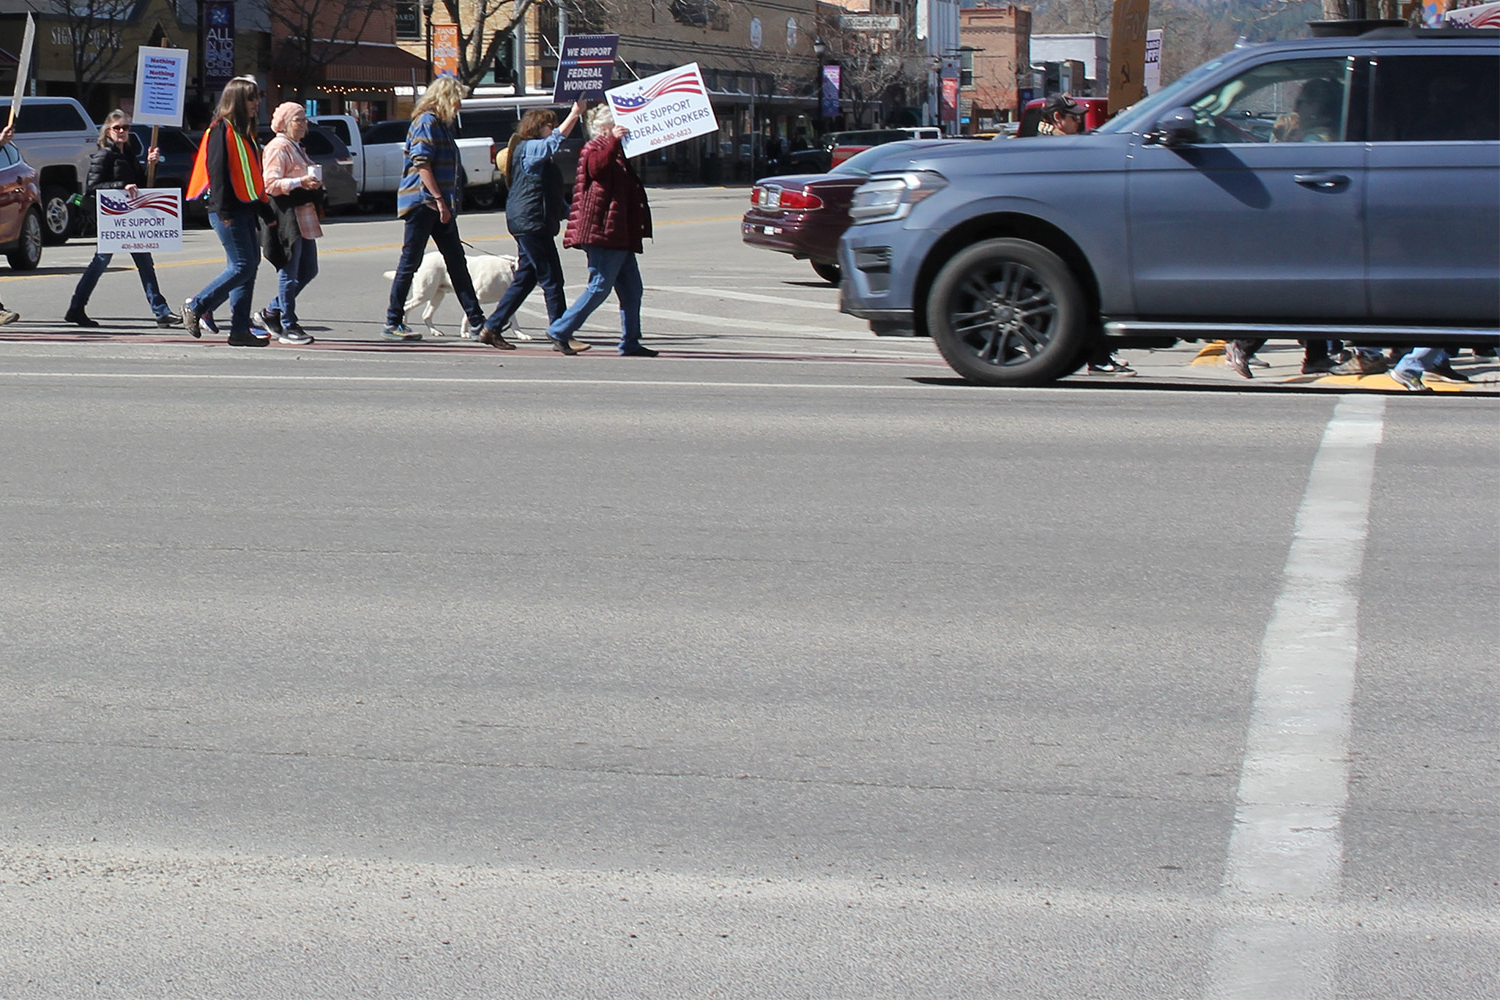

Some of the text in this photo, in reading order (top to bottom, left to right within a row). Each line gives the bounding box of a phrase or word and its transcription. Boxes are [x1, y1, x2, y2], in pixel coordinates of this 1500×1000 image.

[206, 27, 233, 41] ALL
[567, 48, 579, 57] WE
[580, 47, 612, 57] SUPPORT
[150, 58, 176, 66] Nothing
[567, 68, 603, 78] FEDERAL
[564, 80, 604, 91] WORKERS
[633, 99, 691, 124] WE SUPPORT
[625, 107, 710, 141] FEDERAL WORKERS
[649, 128, 692, 146] 406-880-6823
[114, 218, 165, 227] WE SUPPORT
[101, 230, 179, 240] FEDERAL WORKERS
